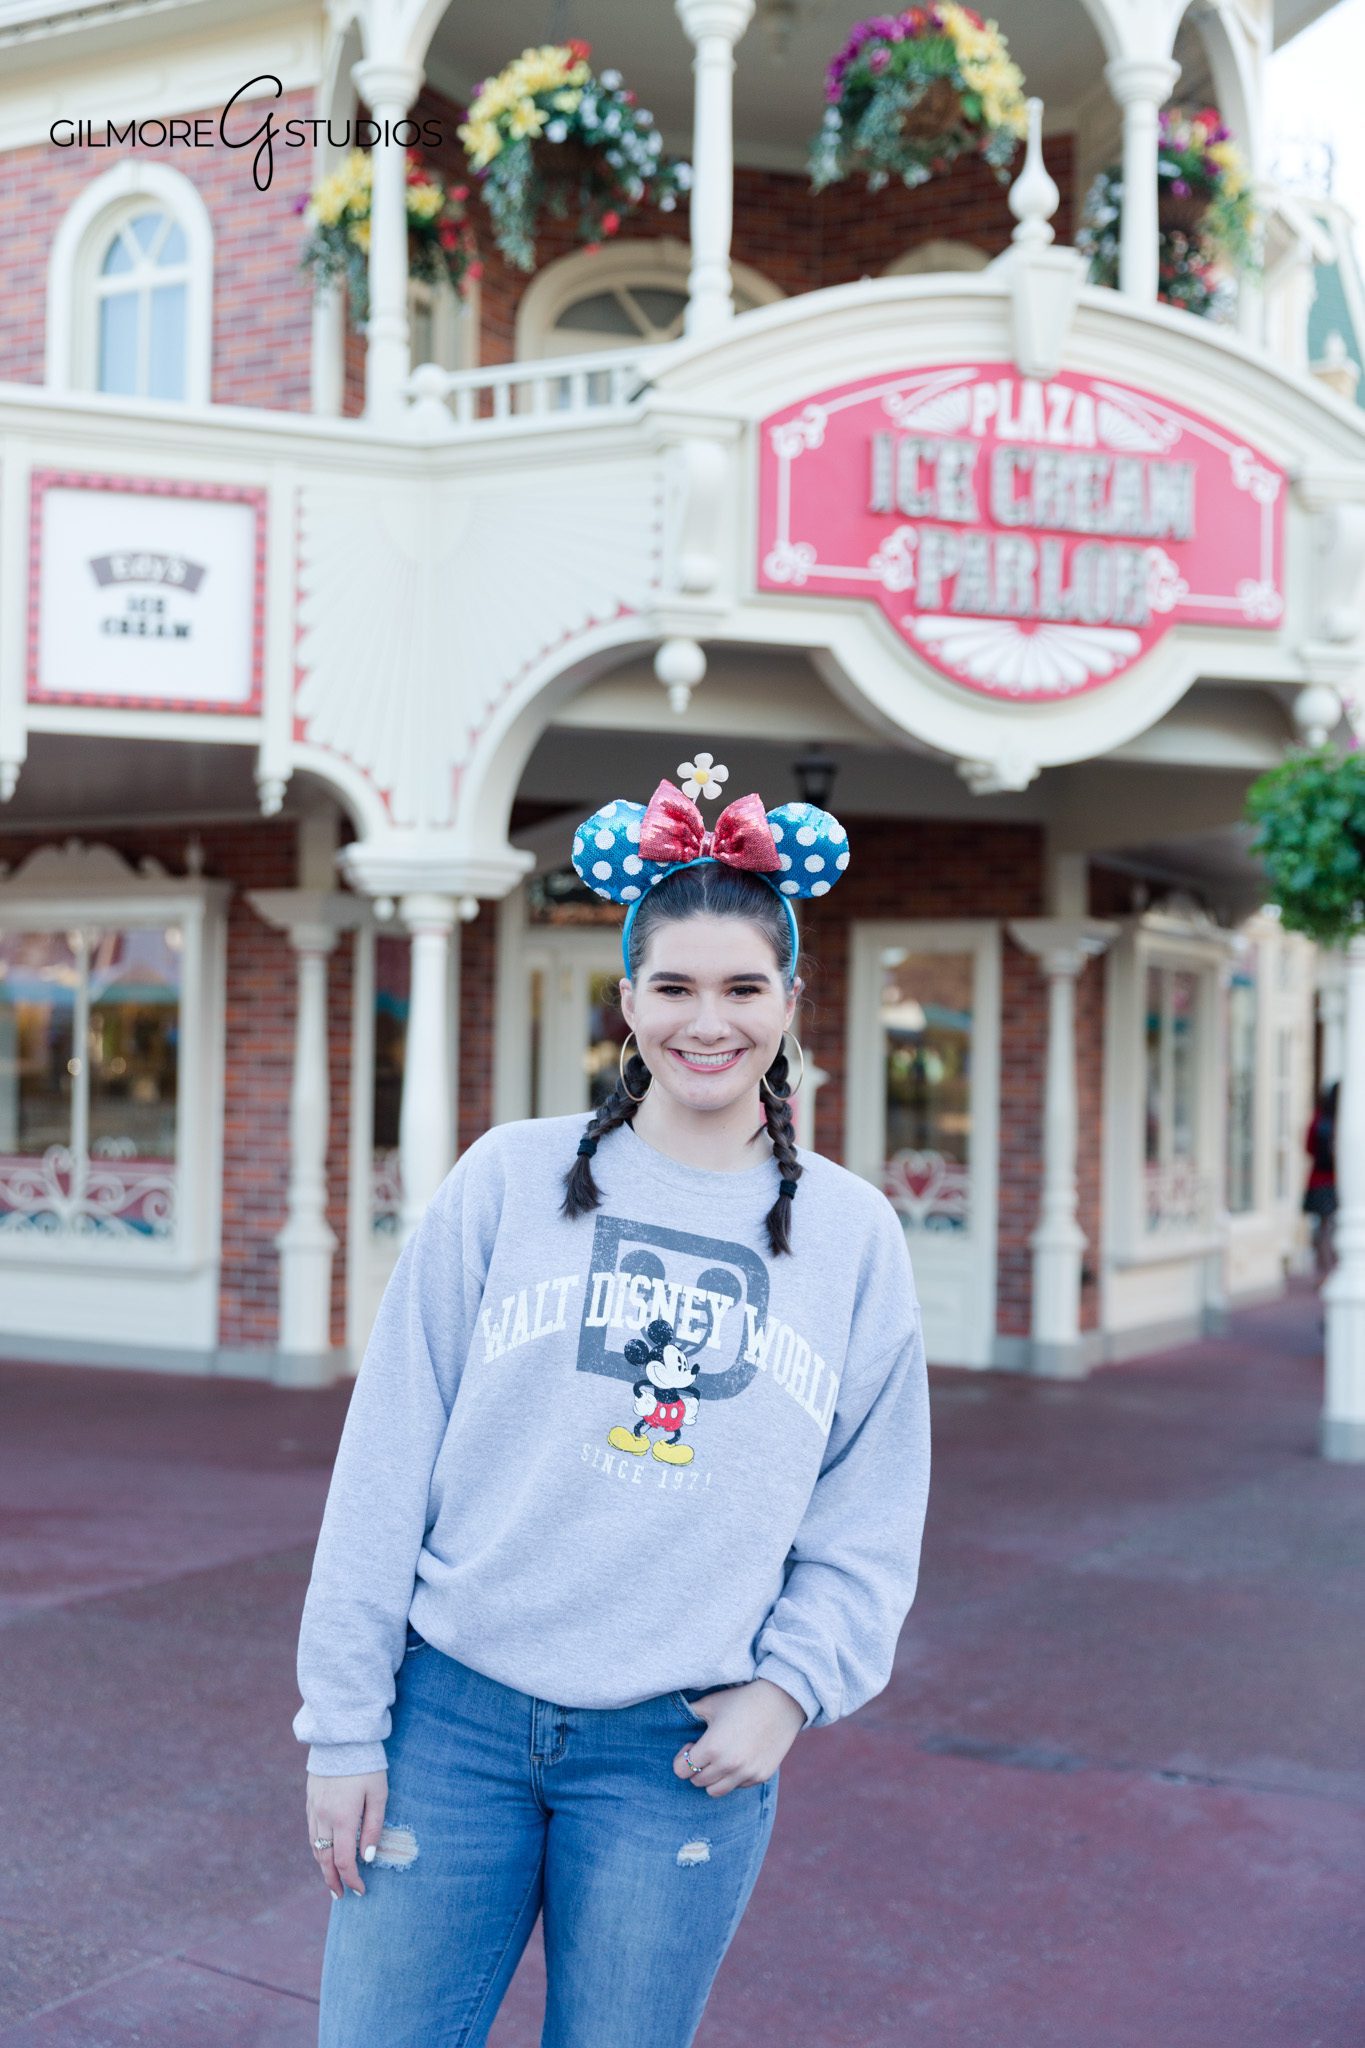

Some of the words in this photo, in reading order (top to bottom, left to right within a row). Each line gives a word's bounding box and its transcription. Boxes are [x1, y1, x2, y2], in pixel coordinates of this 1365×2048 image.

[970, 379, 1097, 447] PLAZA
[868, 431, 980, 523] ICE
[990, 443, 1197, 541] CREAM
[127, 597, 166, 614] ICE
[914, 526, 1153, 628] PARLOR
[101, 618, 191, 638] CREAM
[481, 1275, 580, 1364] WALT
[585, 1272, 734, 1350] DISNEY
[744, 1303, 841, 1437] WORLD
[580, 1443, 644, 1485] SINCE
[657, 1469, 712, 1491] 1971
